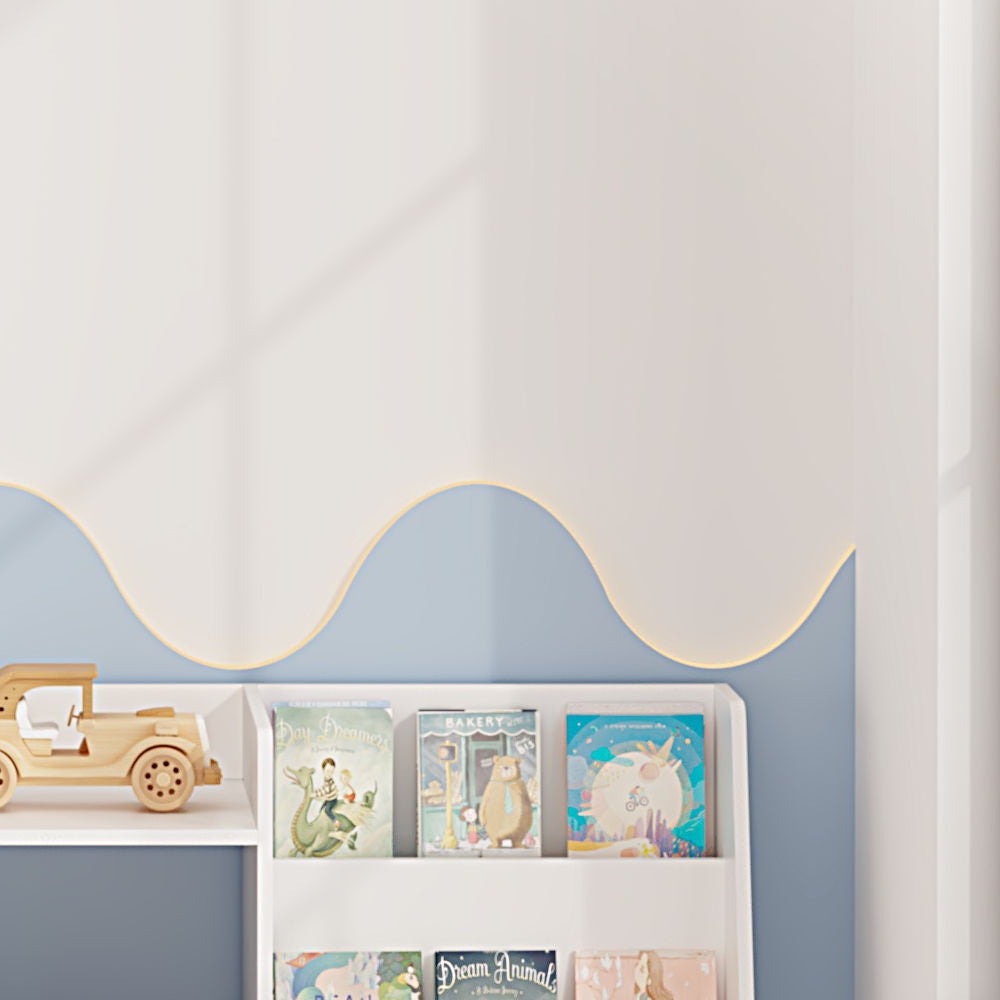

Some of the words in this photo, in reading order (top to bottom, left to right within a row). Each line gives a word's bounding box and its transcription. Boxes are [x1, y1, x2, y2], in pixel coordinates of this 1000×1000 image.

[445, 715, 505, 729] BAKERY
[436, 956, 492, 995] Dream
[493, 950, 558, 994] Animals
